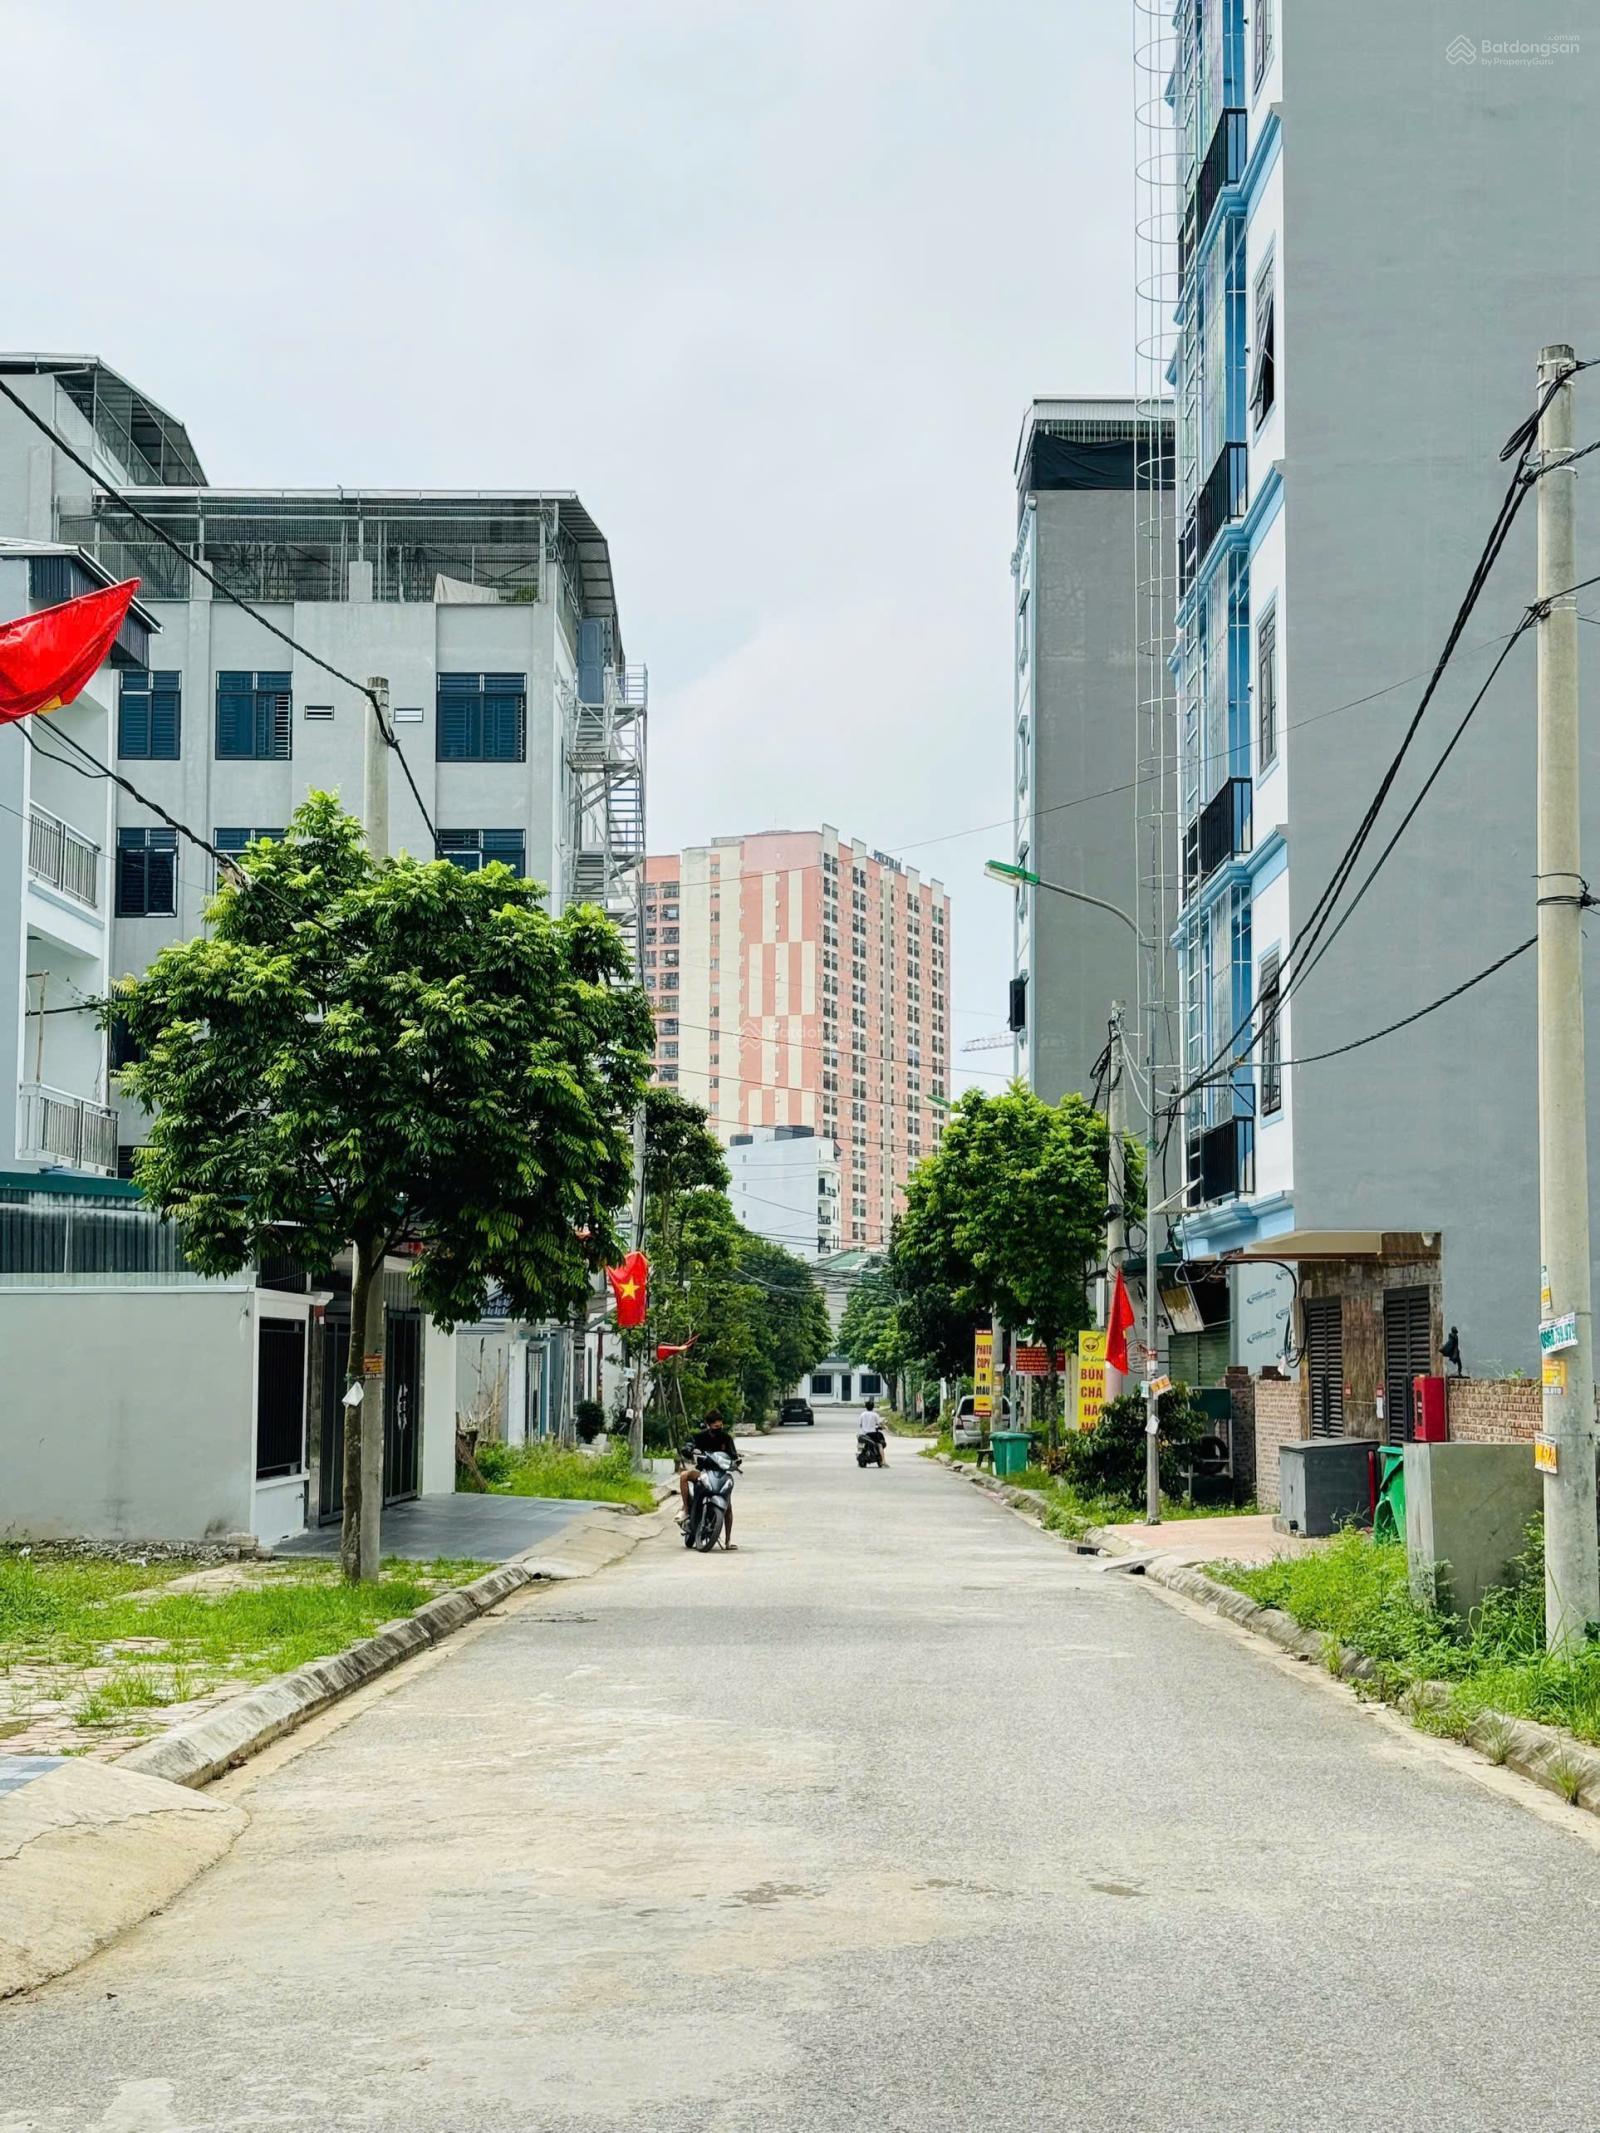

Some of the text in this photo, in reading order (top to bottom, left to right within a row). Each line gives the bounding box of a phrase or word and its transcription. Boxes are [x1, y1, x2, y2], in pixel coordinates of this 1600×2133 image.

[976, 1344, 992, 1354] PHOTO
[976, 1357, 990, 1368] COPY
[1080, 1366, 1104, 1380] BÚN
